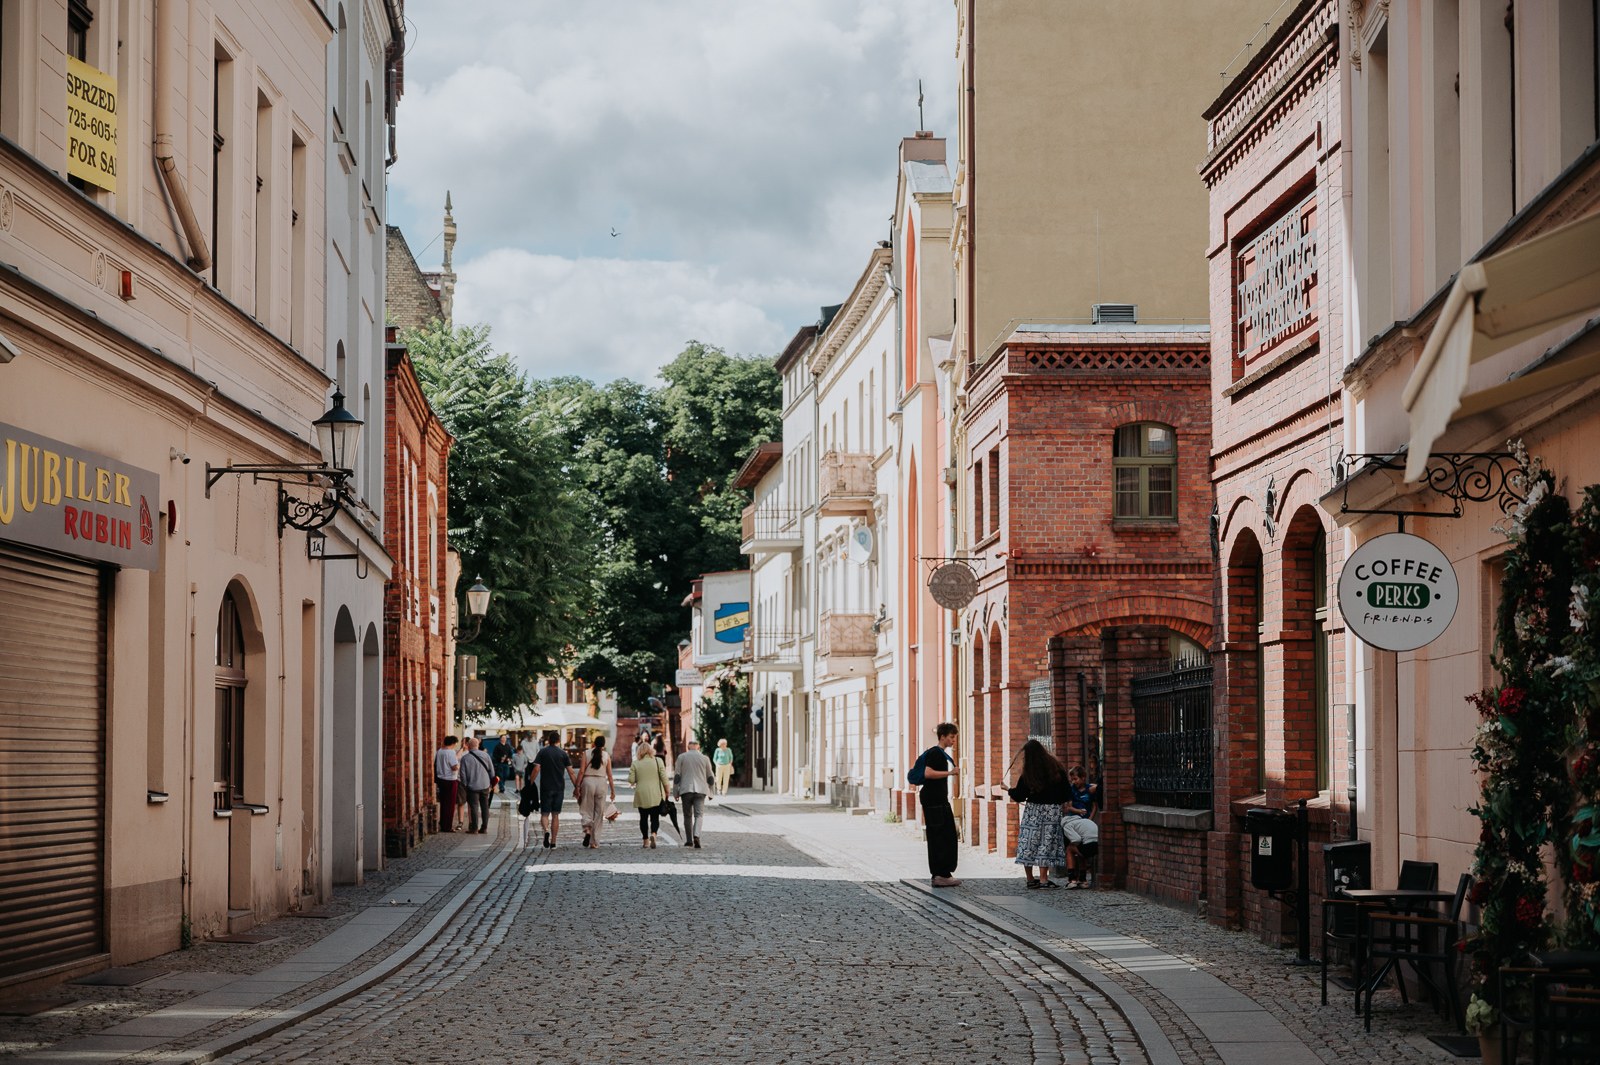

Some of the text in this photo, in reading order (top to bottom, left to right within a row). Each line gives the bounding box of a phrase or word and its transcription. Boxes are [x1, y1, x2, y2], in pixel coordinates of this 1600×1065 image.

[67, 72, 117, 115] SPRZED
[69, 137, 116, 177] FOR SA
[0, 438, 132, 525] JUBILER
[64, 505, 132, 550] RUBIN
[1355, 559, 1443, 584] COFFEE
[1376, 584, 1421, 607] PERKS
